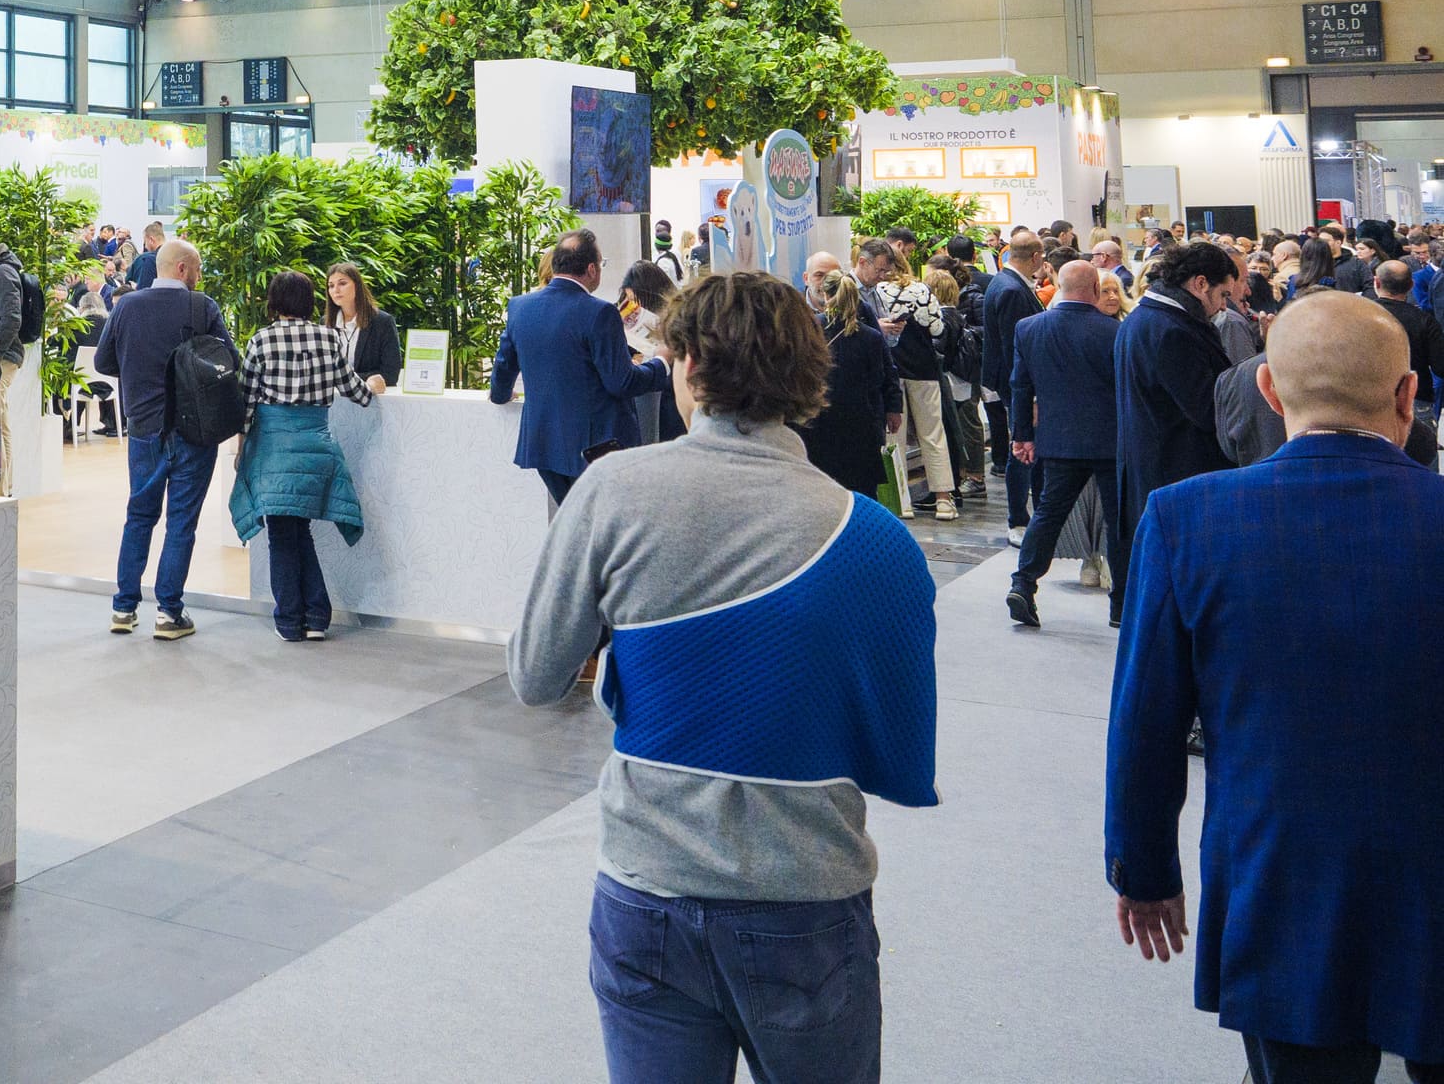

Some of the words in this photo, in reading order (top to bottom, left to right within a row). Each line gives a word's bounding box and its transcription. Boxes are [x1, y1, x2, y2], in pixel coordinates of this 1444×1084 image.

[1320, 5, 1336, 16] C1
[1350, 3, 1367, 15] C4
[1351, 18, 1360, 29] D
[170, 64, 179, 73] C1
[185, 63, 195, 73] C4
[186, 73, 191, 83] D
[889, 133, 899, 141] IL
[901, 131, 944, 141] NOSTRO
[947, 130, 1007, 140] PRODOTTO
[1009, 127, 1016, 139] È
[55, 161, 98, 179] PreGel
[993, 178, 1036, 188] FACILE
